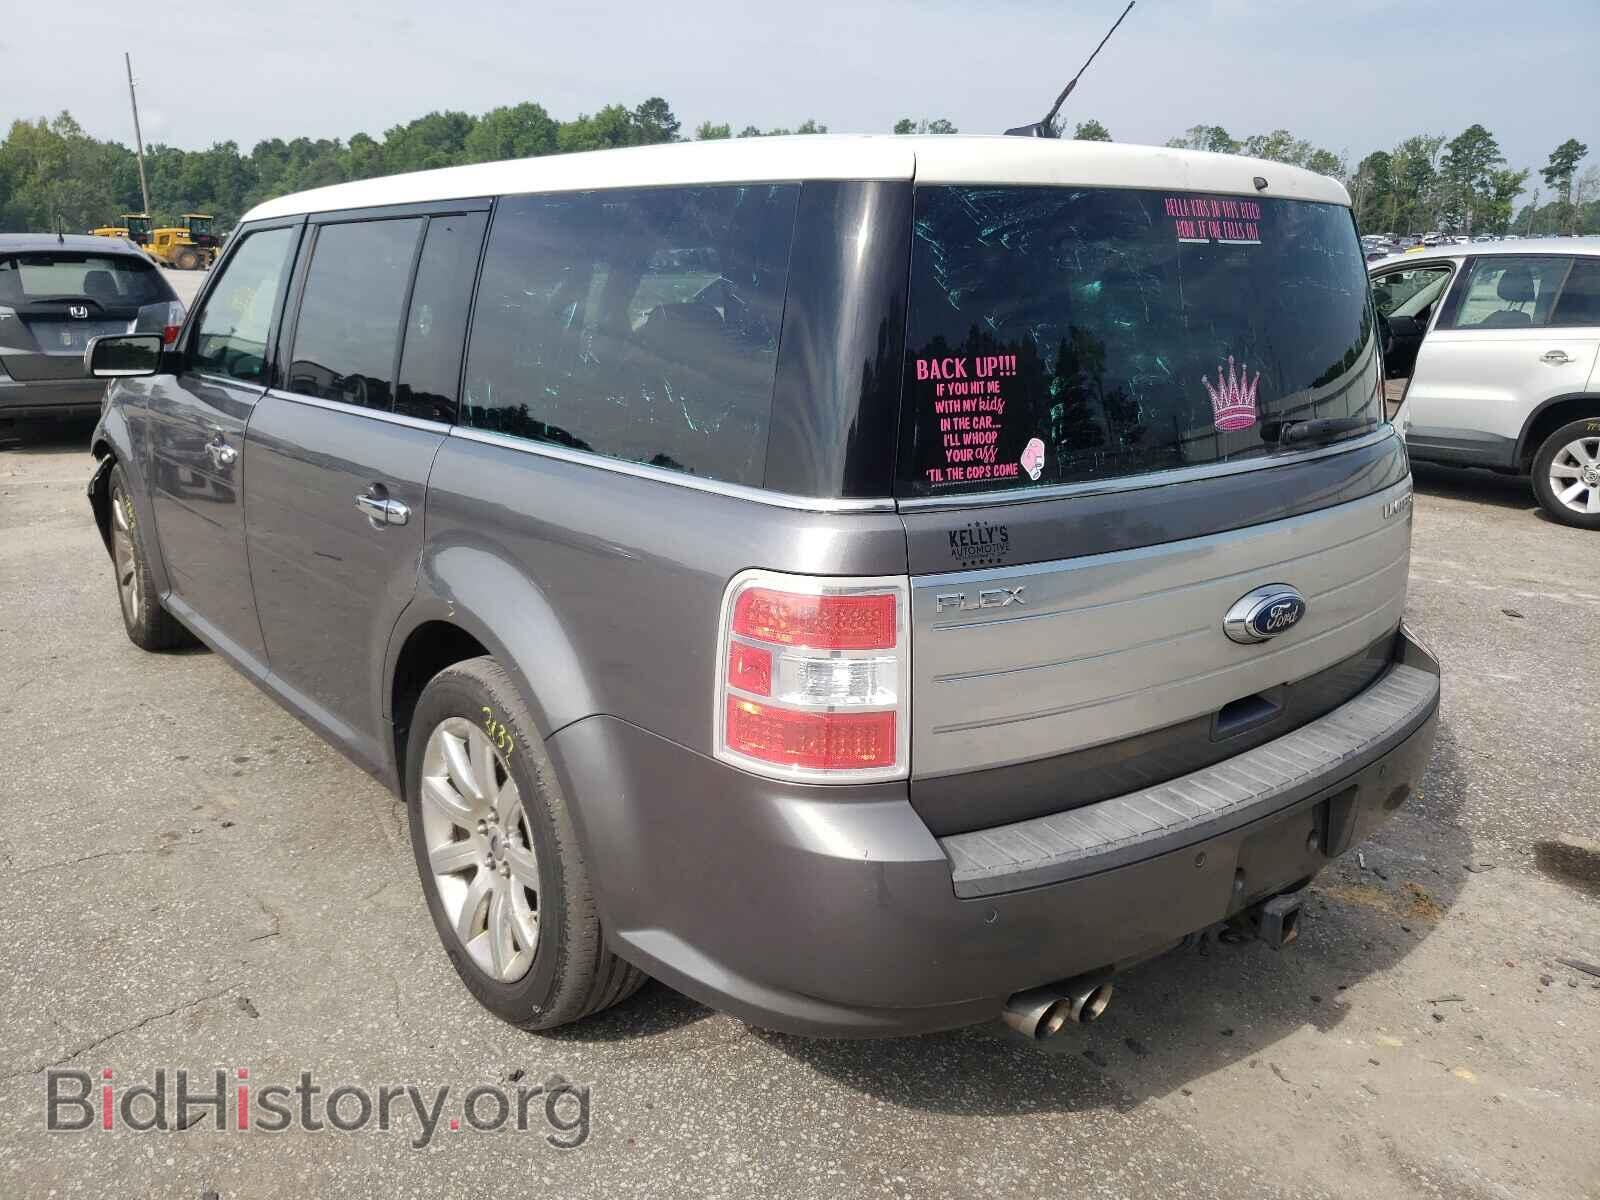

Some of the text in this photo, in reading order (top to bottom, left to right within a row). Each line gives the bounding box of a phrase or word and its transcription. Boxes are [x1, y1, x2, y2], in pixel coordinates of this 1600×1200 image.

[1190, 199, 1210, 217] KIDS
[1198, 220, 1207, 238] IF
[1246, 223, 1259, 239] OUT
[916, 355, 1017, 380] BACK UP!!!
[936, 380, 1000, 397] IF YOU HIT ME
[935, 395, 1005, 414] WITH MY kids
[940, 416, 1002, 432] IN THE CAR...
[943, 431, 998, 447] I'LL WHOOP
[945, 448, 974, 463] YOUR
[926, 463, 1019, 483] 'TIL THE COPS COME
[948, 525, 1009, 548] KELLY'S
[951, 543, 1010, 558] AUTOMOTIVE
[936, 585, 1026, 614] FLEX
[1266, 602, 1300, 631] Ford
